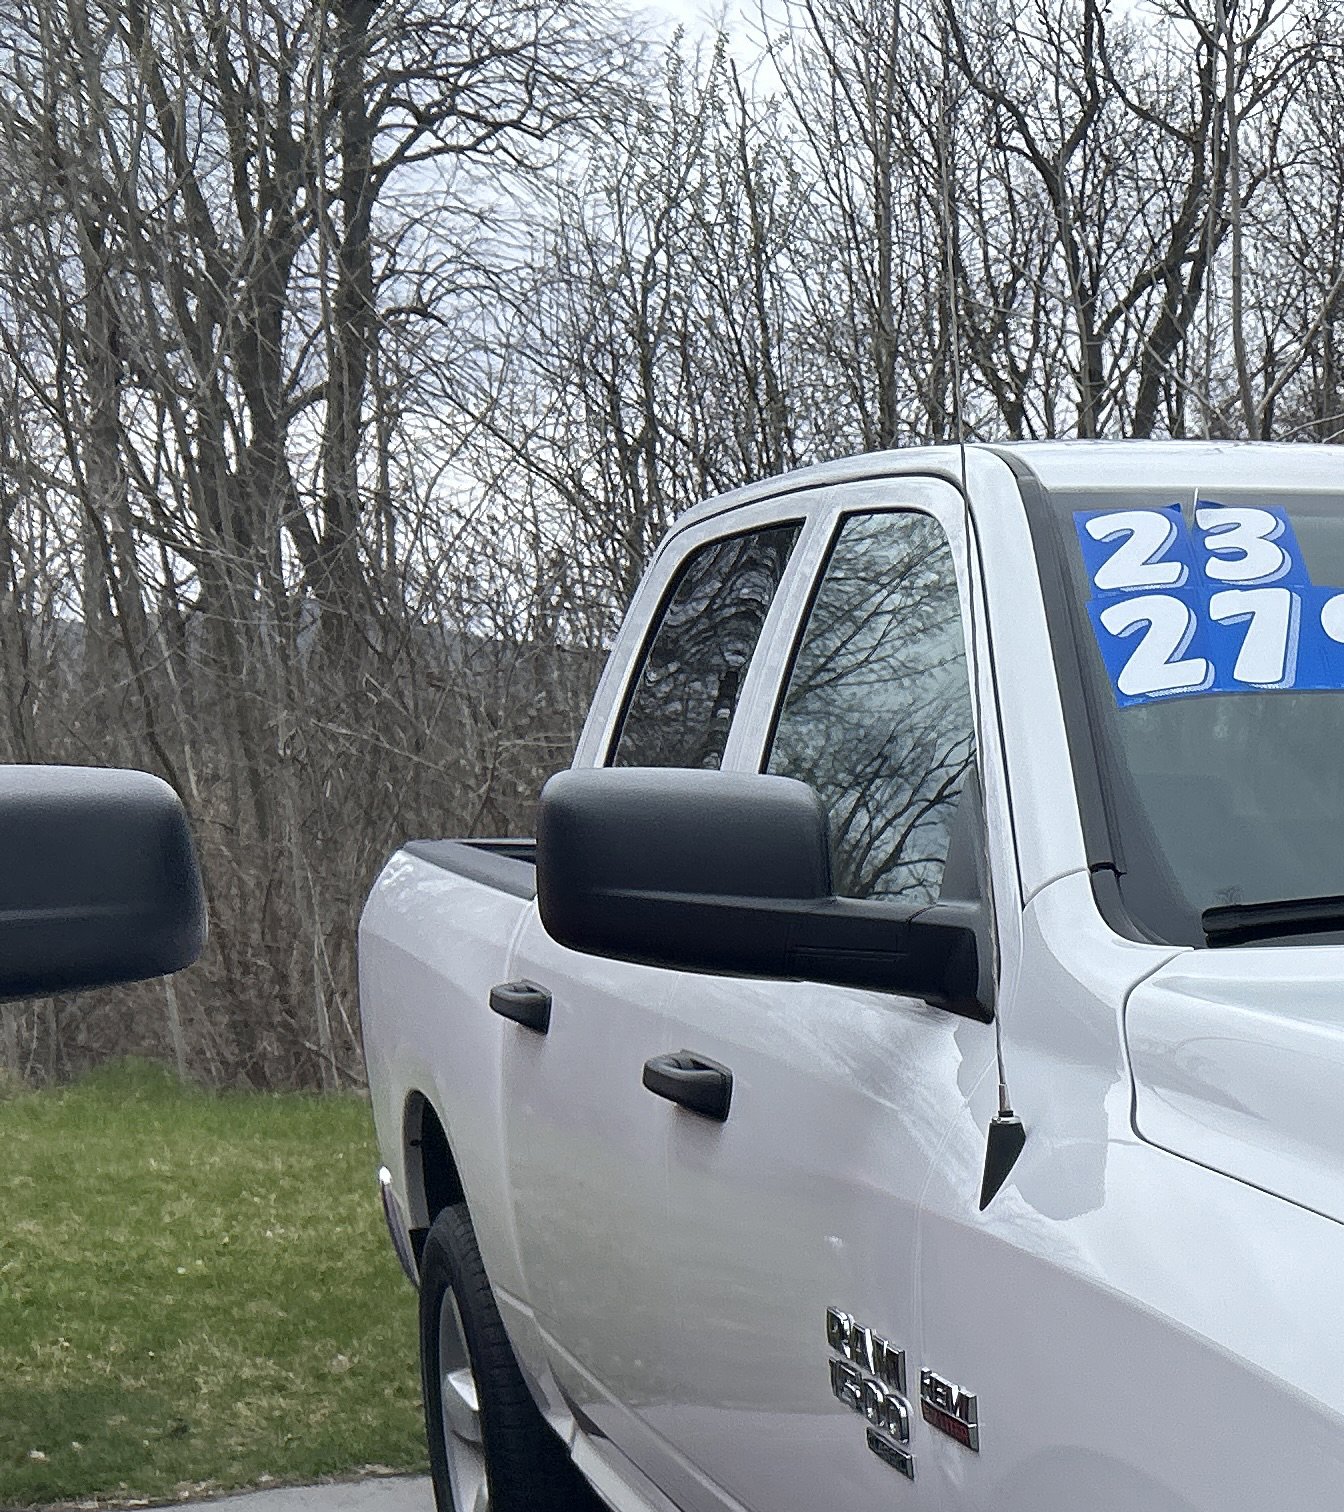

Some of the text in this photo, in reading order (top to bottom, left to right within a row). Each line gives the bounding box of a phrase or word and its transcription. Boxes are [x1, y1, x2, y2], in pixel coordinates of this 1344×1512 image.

[1085, 506, 1292, 592] 23
[826, 1305, 907, 1398] RAM
[828, 1357, 912, 1444] 1500
